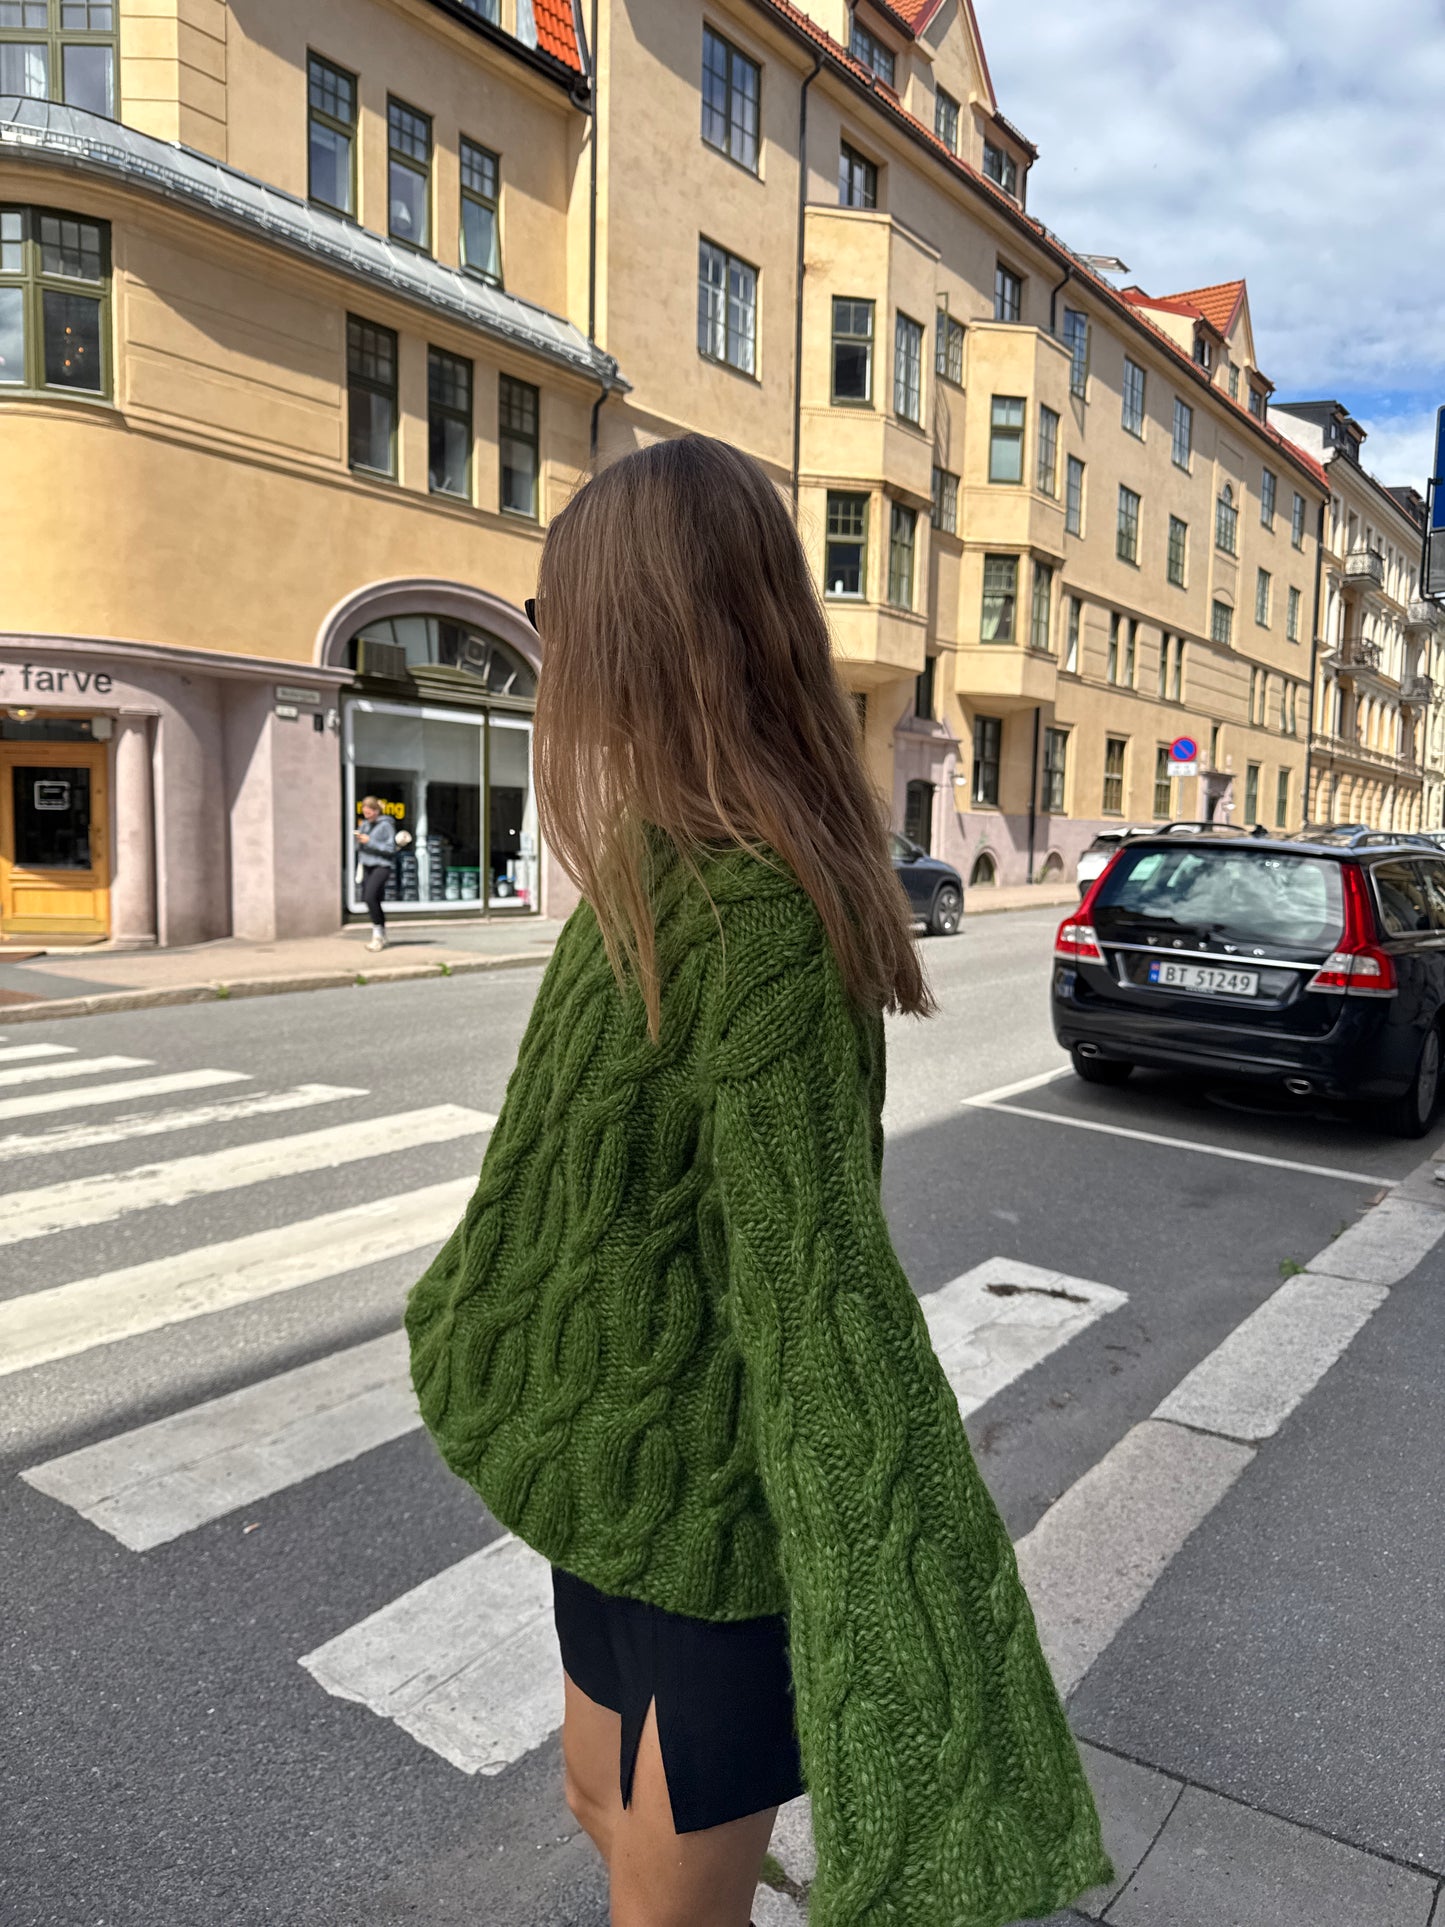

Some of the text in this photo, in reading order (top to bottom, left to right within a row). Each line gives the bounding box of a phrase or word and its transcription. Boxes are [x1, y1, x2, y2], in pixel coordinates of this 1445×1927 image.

[20, 663, 112, 693] farve
[1166, 966, 1188, 983] BT
[1196, 969, 1251, 991] 51249
